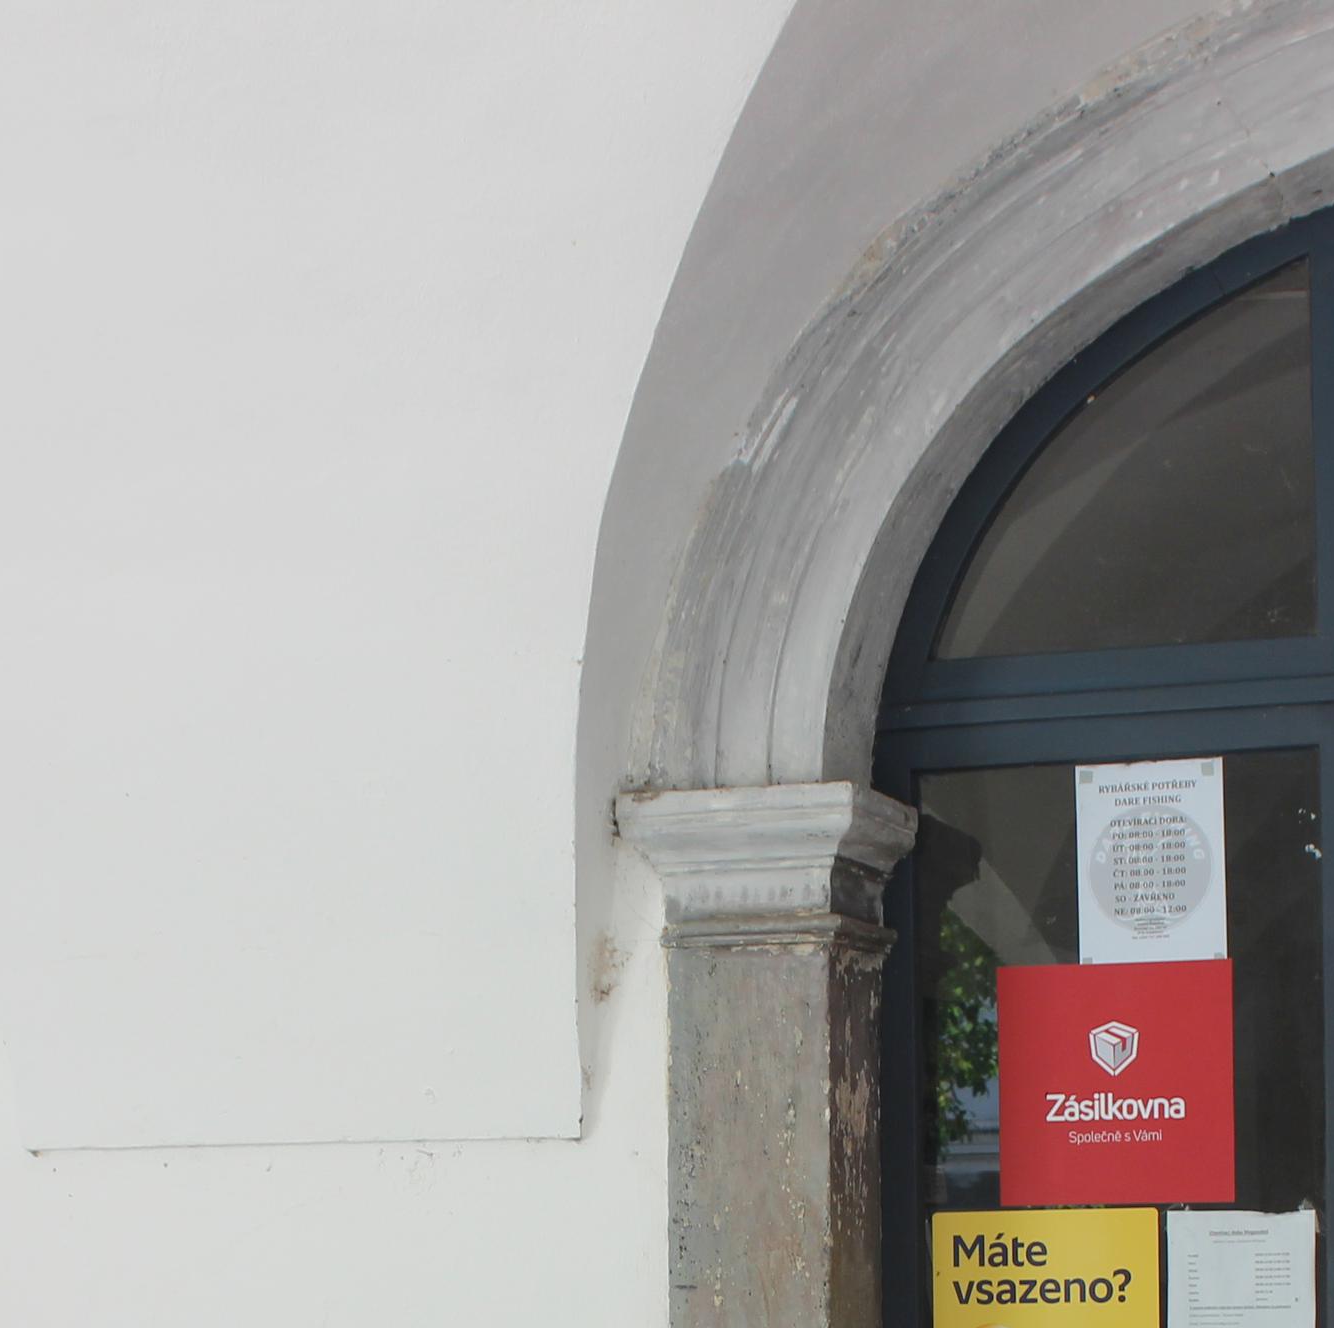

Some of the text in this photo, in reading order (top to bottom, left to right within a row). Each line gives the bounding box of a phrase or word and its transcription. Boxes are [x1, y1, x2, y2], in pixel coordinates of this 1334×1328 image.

[1151, 778, 1197, 790] POTŘEBY
[1115, 794, 1181, 807] DARE FISHING
[1045, 1092, 1186, 1123] Zásilkovna
[1068, 1129, 1163, 1146] Společně s Vámi
[952, 1233, 1048, 1267] Máte
[952, 1269, 1132, 1305] vsazeno?
